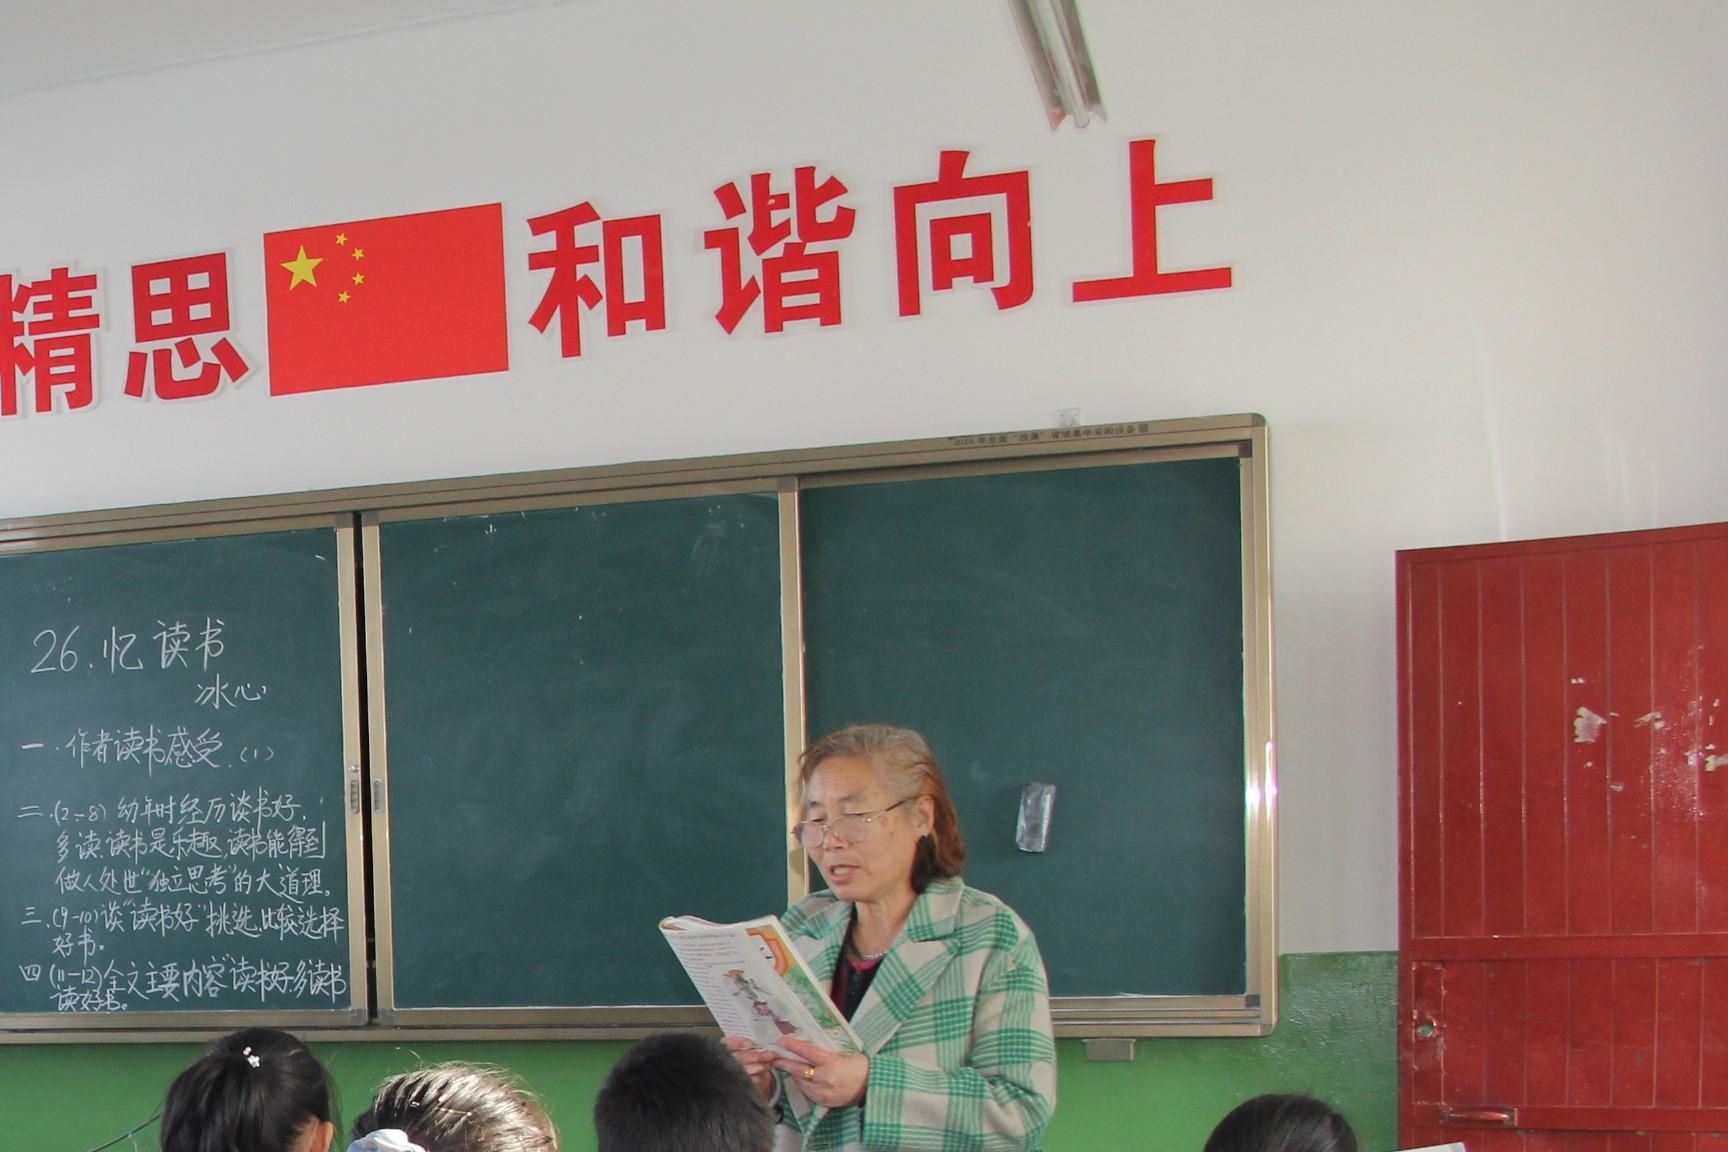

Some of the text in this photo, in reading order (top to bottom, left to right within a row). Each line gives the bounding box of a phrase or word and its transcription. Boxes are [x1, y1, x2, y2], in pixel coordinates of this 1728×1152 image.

[527, 137, 1233, 360] 和谐向上
[194, 673, 267, 710] 冰心
